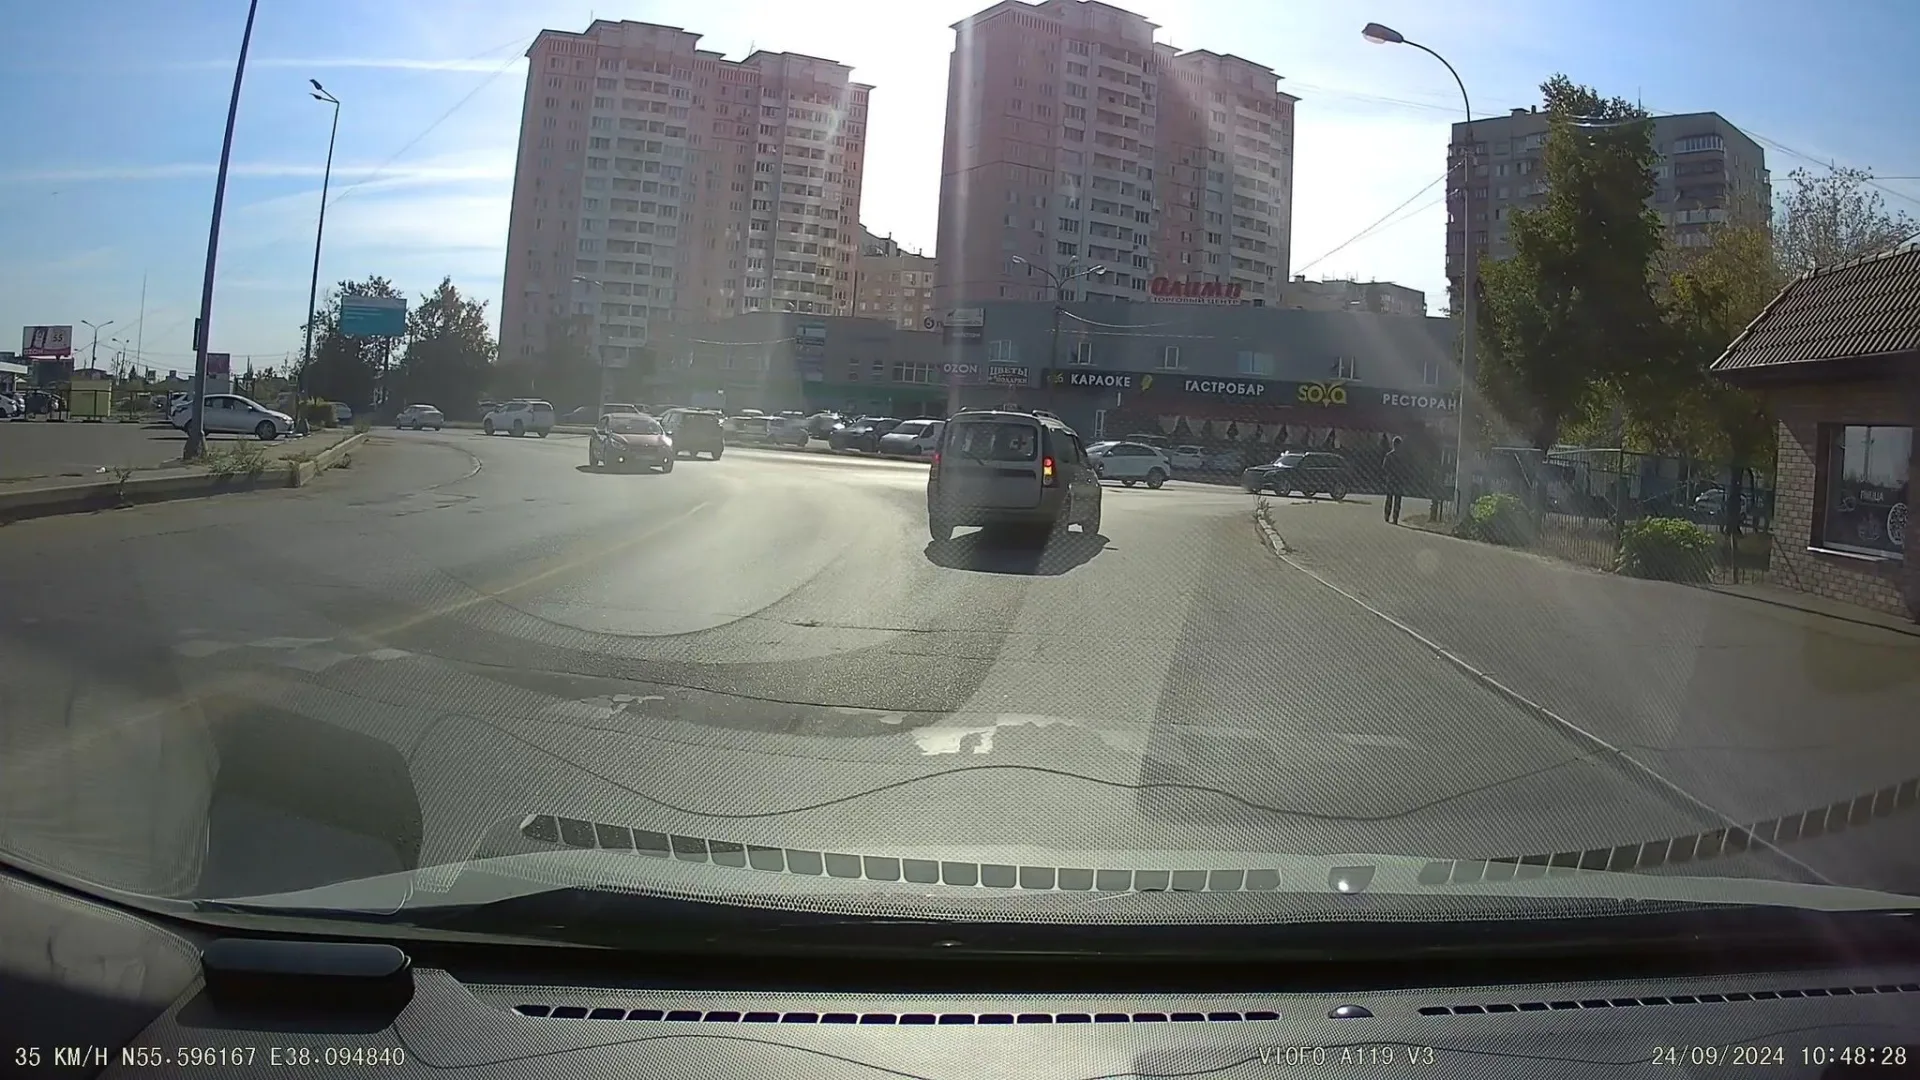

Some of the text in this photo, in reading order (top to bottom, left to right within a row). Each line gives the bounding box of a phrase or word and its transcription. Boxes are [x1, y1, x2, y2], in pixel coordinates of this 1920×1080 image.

[943, 363, 978, 373] OZON
[990, 366, 1028, 377] ЦВЕТЫ
[1071, 374, 1131, 387] КАРАОКЕ
[1185, 380, 1264, 395] ГАСТРОБАР
[1382, 393, 1457, 410] РЕСТОРАН
